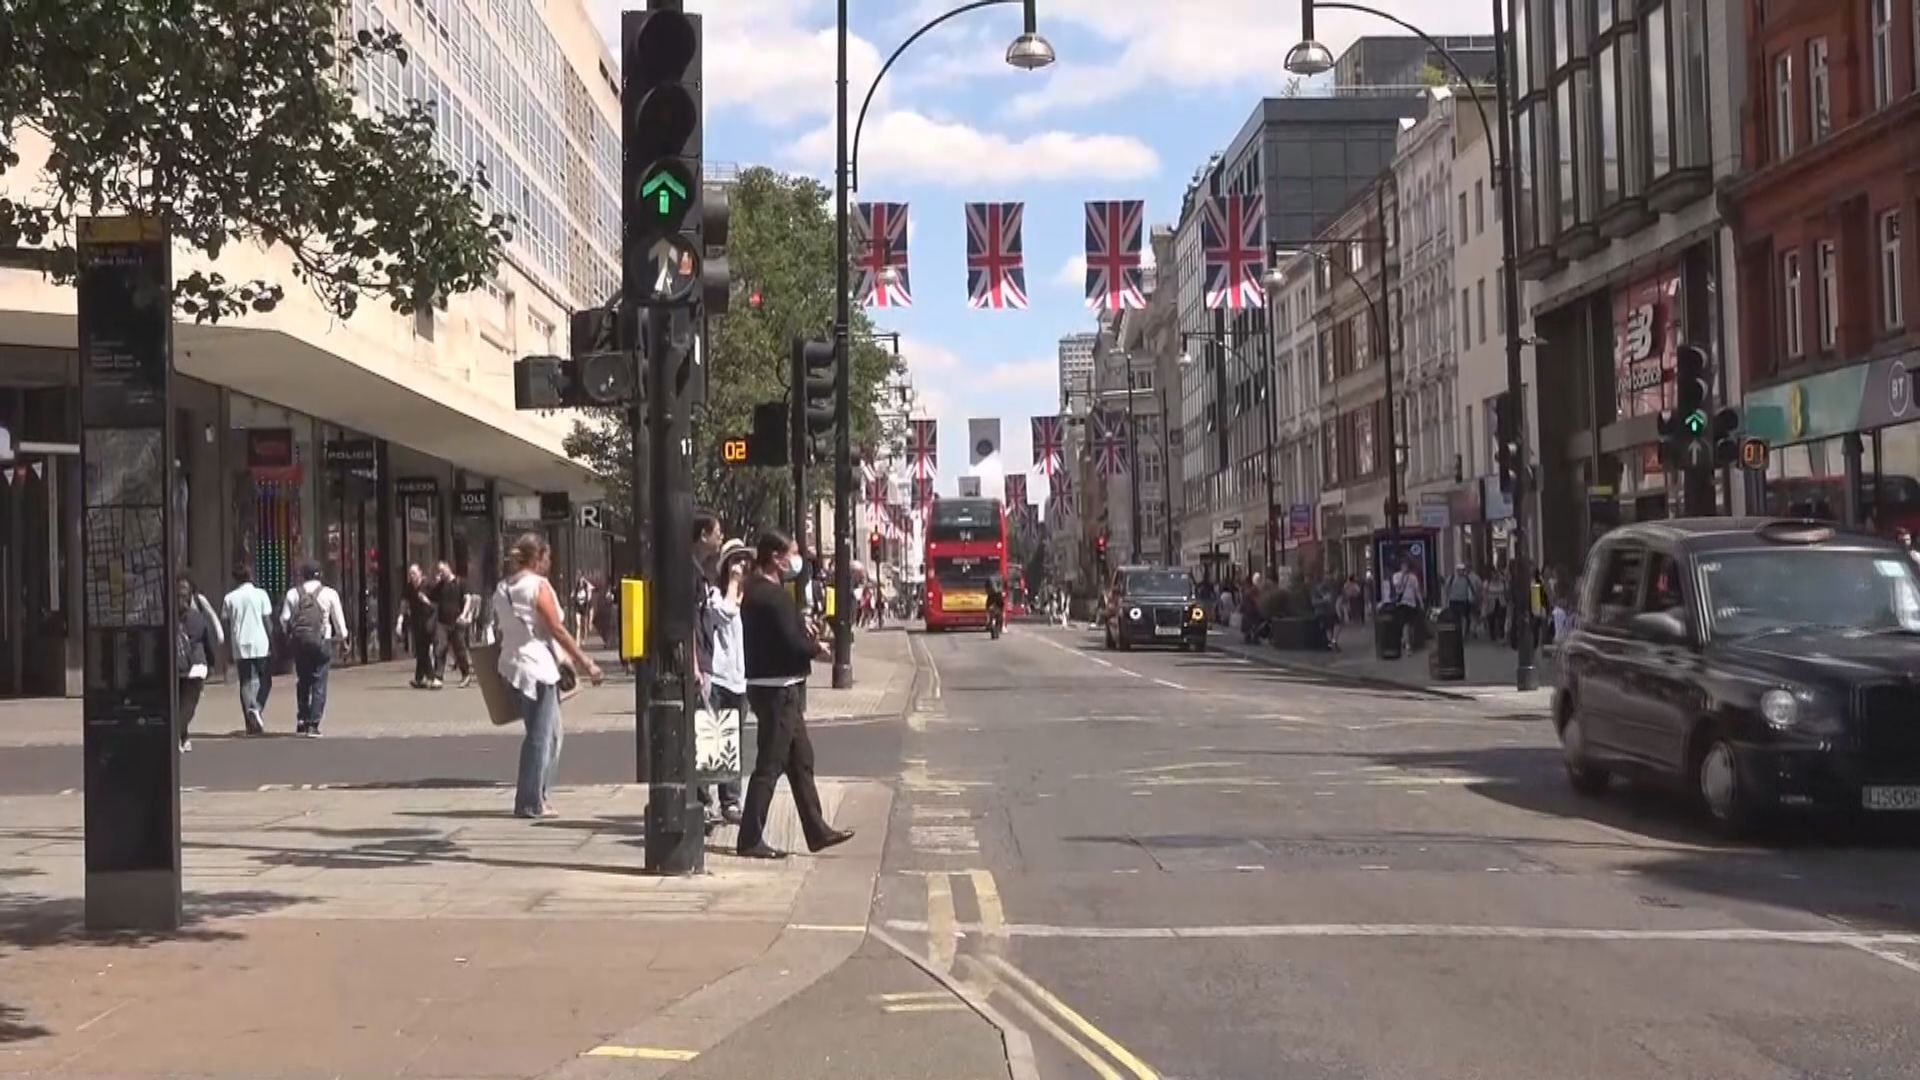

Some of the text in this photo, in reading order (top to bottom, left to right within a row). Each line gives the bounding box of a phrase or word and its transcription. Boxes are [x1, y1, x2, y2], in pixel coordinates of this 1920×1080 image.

[1892, 378, 1904, 400] BT
[725, 441, 746, 459] 02
[460, 493, 486, 503] SOLE
